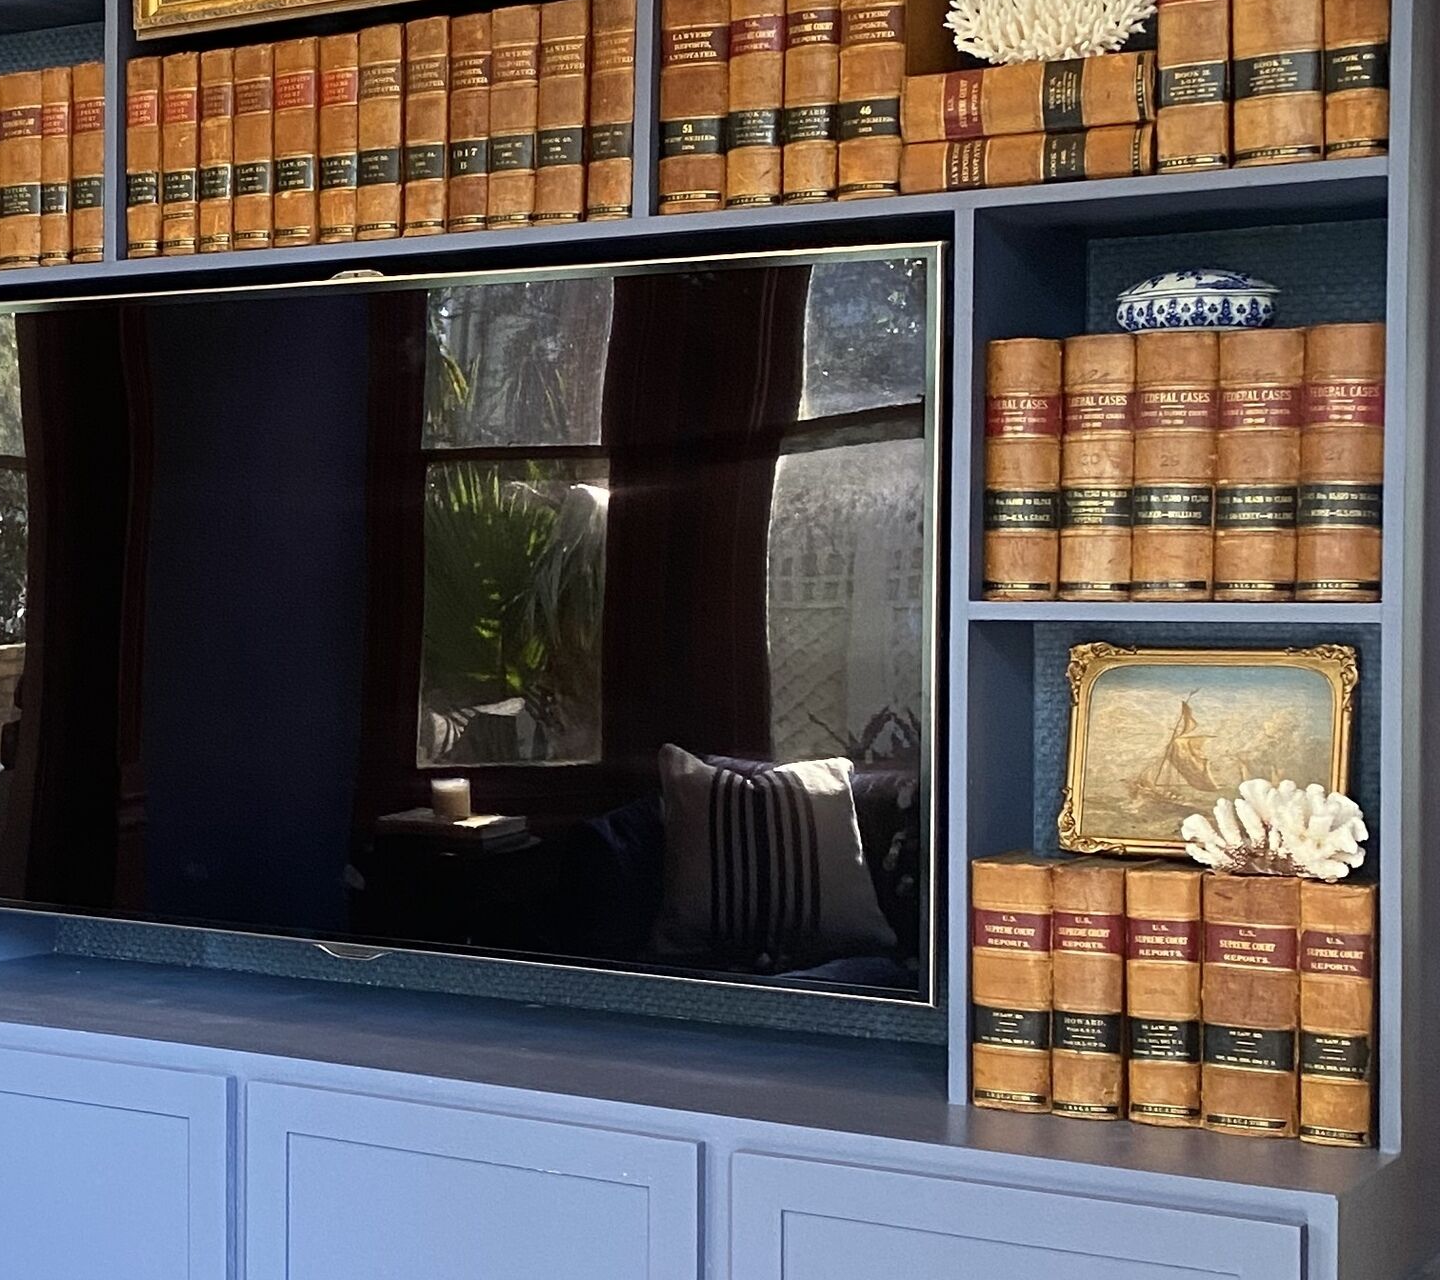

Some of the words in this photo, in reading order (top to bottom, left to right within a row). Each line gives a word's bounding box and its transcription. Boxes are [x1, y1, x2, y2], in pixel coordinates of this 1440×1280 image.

[813, 22, 834, 31] COURT
[672, 31, 713, 42] LAWYERS'
[1174, 70, 1198, 80] BOOK
[859, 105, 872, 115] 46
[682, 124, 693, 134] 51
[453, 148, 477, 159] 1917
[1262, 389, 1292, 400] CASES
[1350, 385, 1380, 397] CASES
[1098, 395, 1127, 406] CASES
[1180, 391, 1210, 403] CASES
[1019, 399, 1049, 410] CASES
[1002, 915, 1017, 923] U.S.
[1074, 916, 1092, 925] U.S.
[985, 924, 1012, 936] SUPREME
[1013, 926, 1036, 937] COURT
[1059, 926, 1087, 937] SUPREME
[1088, 928, 1111, 938] COURT
[1151, 924, 1168, 932] U.S.
[1238, 928, 1257, 937] U.S.
[987, 937, 1030, 948] REPORTS.
[1062, 939, 1107, 950] REPORTS.
[1134, 935, 1165, 945] SUPREME
[1165, 936, 1188, 946] COURT
[1219, 939, 1250, 951] SUPREME
[1251, 942, 1276, 953] COURT
[1325, 936, 1345, 945] U.S.
[1138, 948, 1184, 958] REPORTS.
[1223, 953, 1271, 964] REPORTS.
[1307, 947, 1338, 959] SUPREME
[1339, 950, 1364, 961] COURT
[1310, 961, 1359, 972] REPORTS.
[1063, 1016, 1107, 1027] HOWARD.
